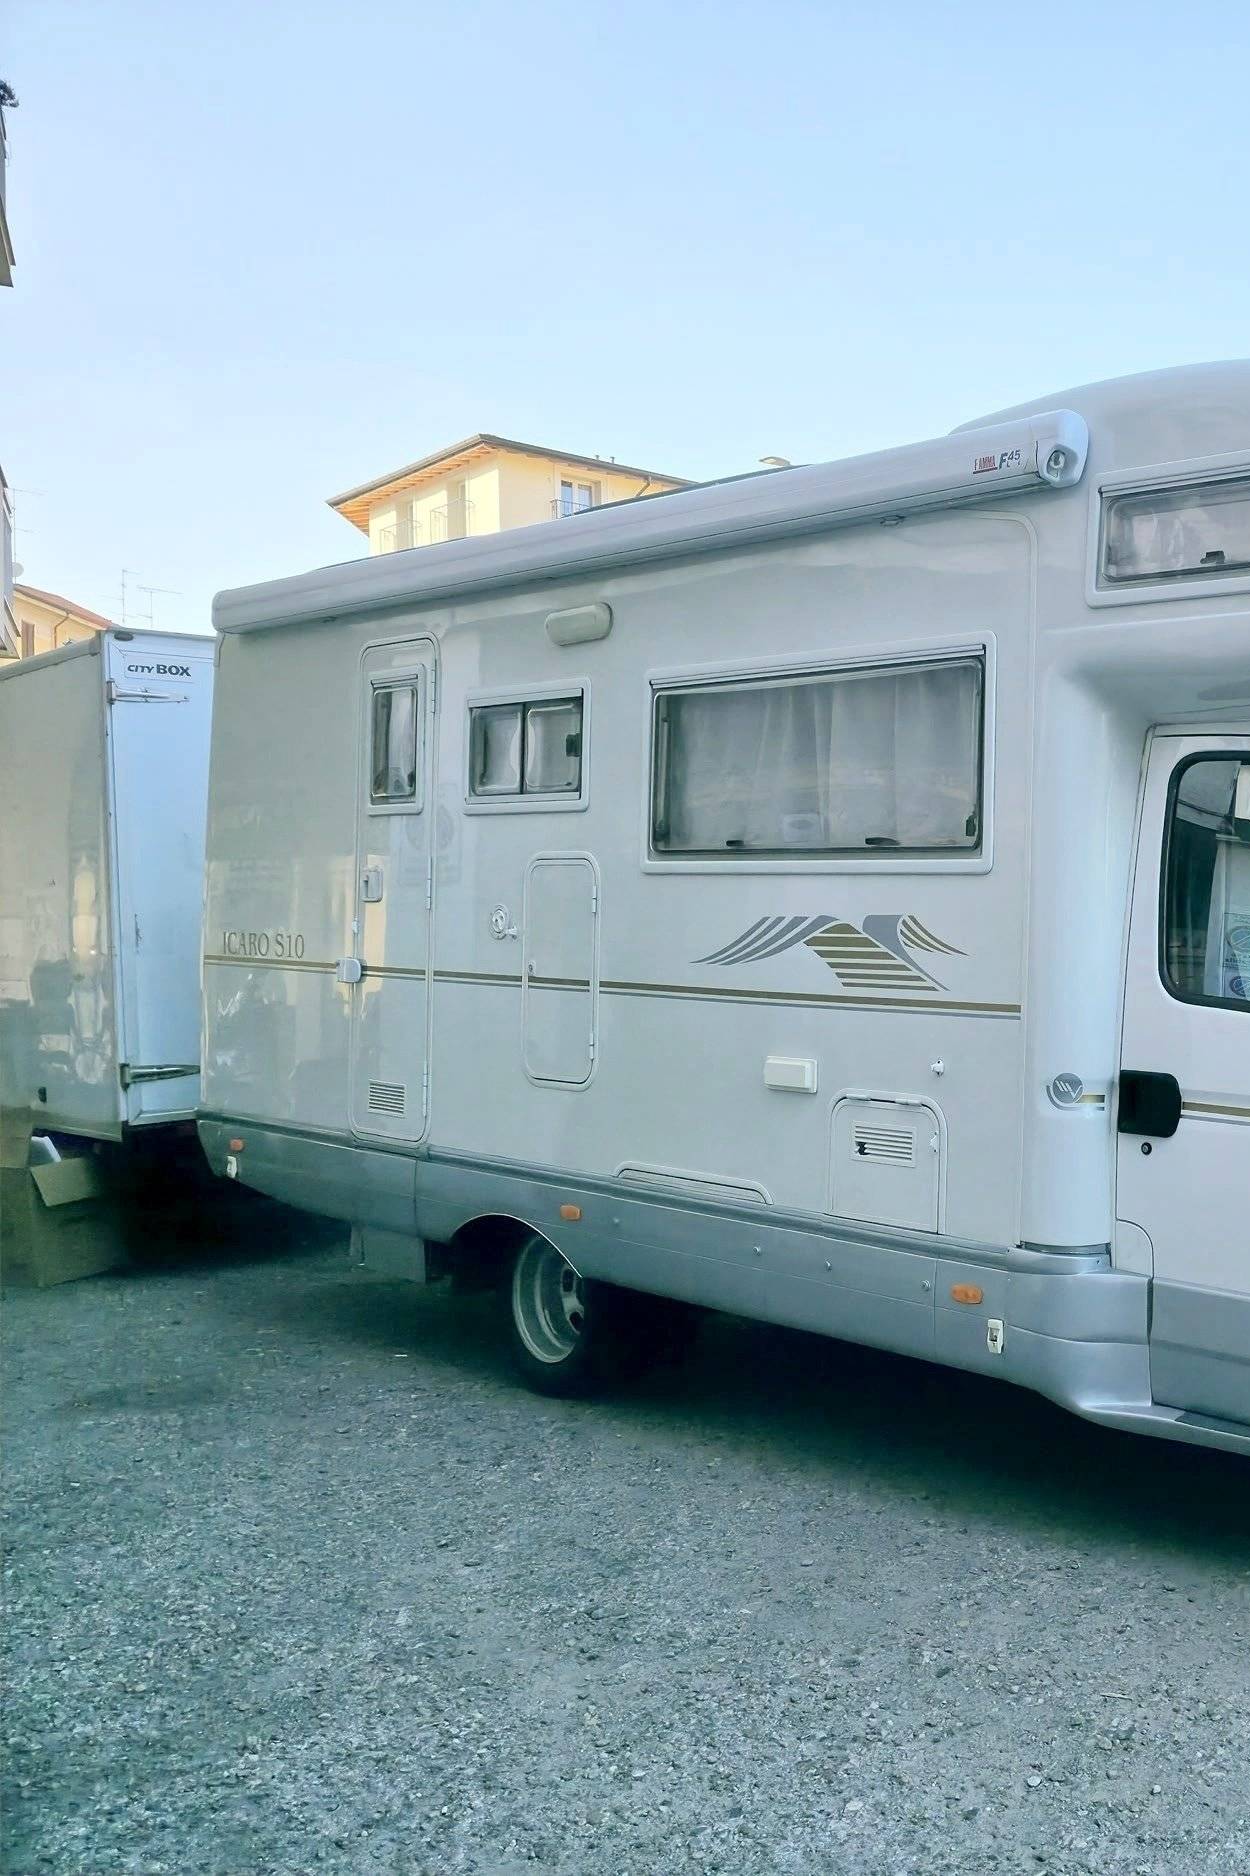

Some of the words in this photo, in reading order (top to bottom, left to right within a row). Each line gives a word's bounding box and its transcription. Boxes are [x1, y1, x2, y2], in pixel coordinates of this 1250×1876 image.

[974, 455, 996, 471] FAMMA
[127, 664, 154, 673] CITY
[156, 664, 191, 677] BOX
[223, 931, 269, 956] ICARO
[275, 933, 304, 959] S10
